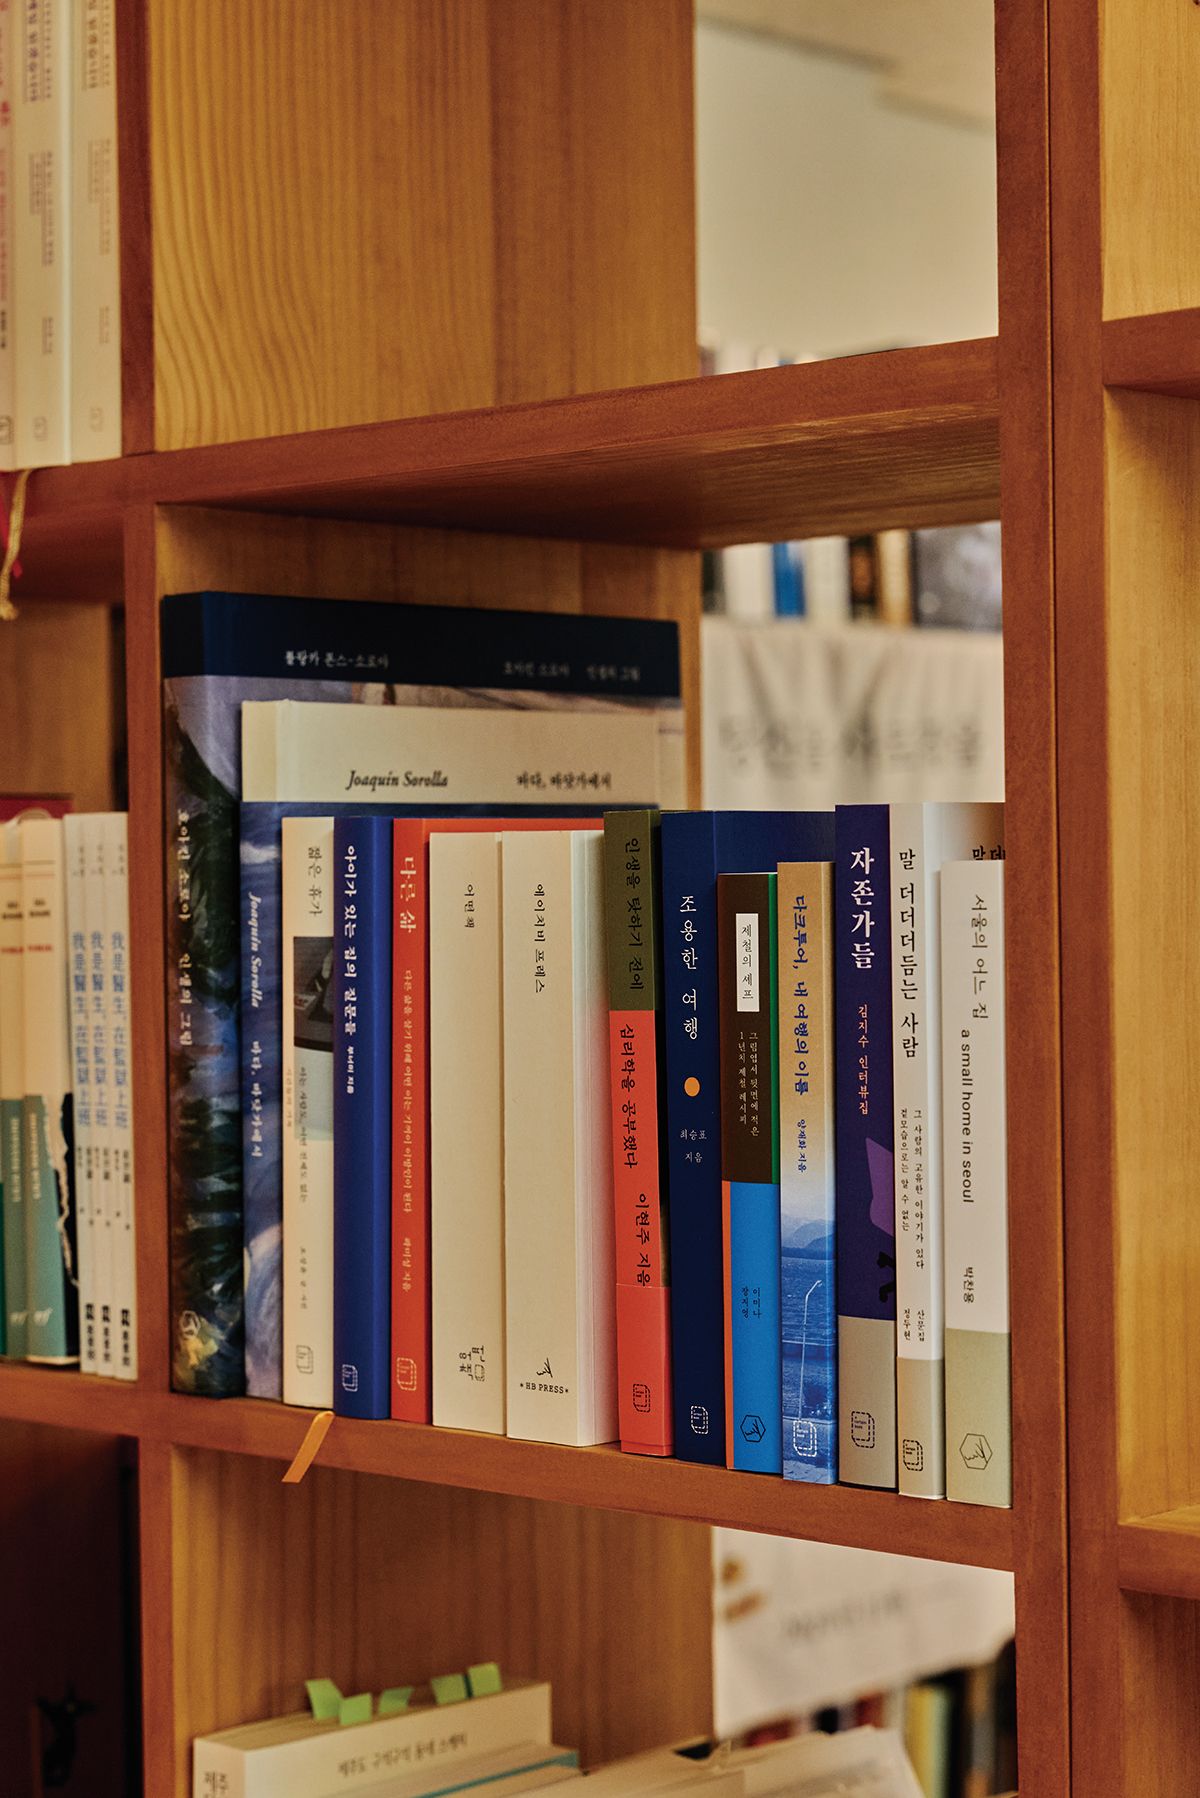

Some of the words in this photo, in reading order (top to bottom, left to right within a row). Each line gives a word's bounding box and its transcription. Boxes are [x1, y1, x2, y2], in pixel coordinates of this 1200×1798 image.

[403, 770, 449, 787] Sorolla
[307, 846, 323, 879] 짧은
[344, 845, 357, 898] 아이가
[399, 856, 417, 903] 다른
[625, 838, 642, 889] 인생을
[899, 848, 916, 870] 말
[308, 884, 322, 917] 휴가
[344, 904, 357, 939] 있는
[399, 909, 417, 934] 삶
[534, 883, 546, 943] 에이치비
[850, 847, 876, 969] 자존가들
[972, 894, 988, 948] 서울의
[627, 897, 643, 948] 탓하기
[680, 895, 698, 970] 조용한
[793, 895, 809, 970] 다크투어,
[900, 882, 918, 1000] 더더더듬는
[344, 946, 357, 978] 집의
[741, 924, 752, 967] 제철의
[250, 955, 263, 1008] Sorolla
[403, 970, 413, 991] 다른
[534, 948, 546, 994] 프레스
[628, 956, 645, 991] 전에
[794, 981, 809, 997] 내
[973, 958, 988, 995] 어느
[344, 986, 357, 1037] 질문들
[682, 988, 699, 1040] 여행
[793, 1003, 809, 1055] 여행의
[858, 1004, 869, 1048] 김지수
[973, 1002, 988, 1019] 집
[901, 1012, 919, 1058] 사람
[961, 1028, 971, 1038] a
[620, 1023, 636, 1093] 심리학을
[794, 1061, 809, 1096] 이름
[962, 1043, 974, 1086] small
[858, 1055, 870, 1115] 인터뷰집
[621, 1099, 638, 1169] 공부했다
[797, 1119, 807, 1150] 양재화
[962, 1092, 974, 1136] home
[684, 1151, 703, 1164] 지음
[797, 1152, 807, 1173] 지음
[962, 1141, 974, 1155] in
[963, 1160, 975, 1203] seoul
[635, 1193, 651, 1246] 이현주
[636, 1252, 651, 1287] 지음
[963, 1266, 975, 1304] 박찬용
[525, 1382, 537, 1391] HB
[538, 1384, 564, 1394] PRESS
